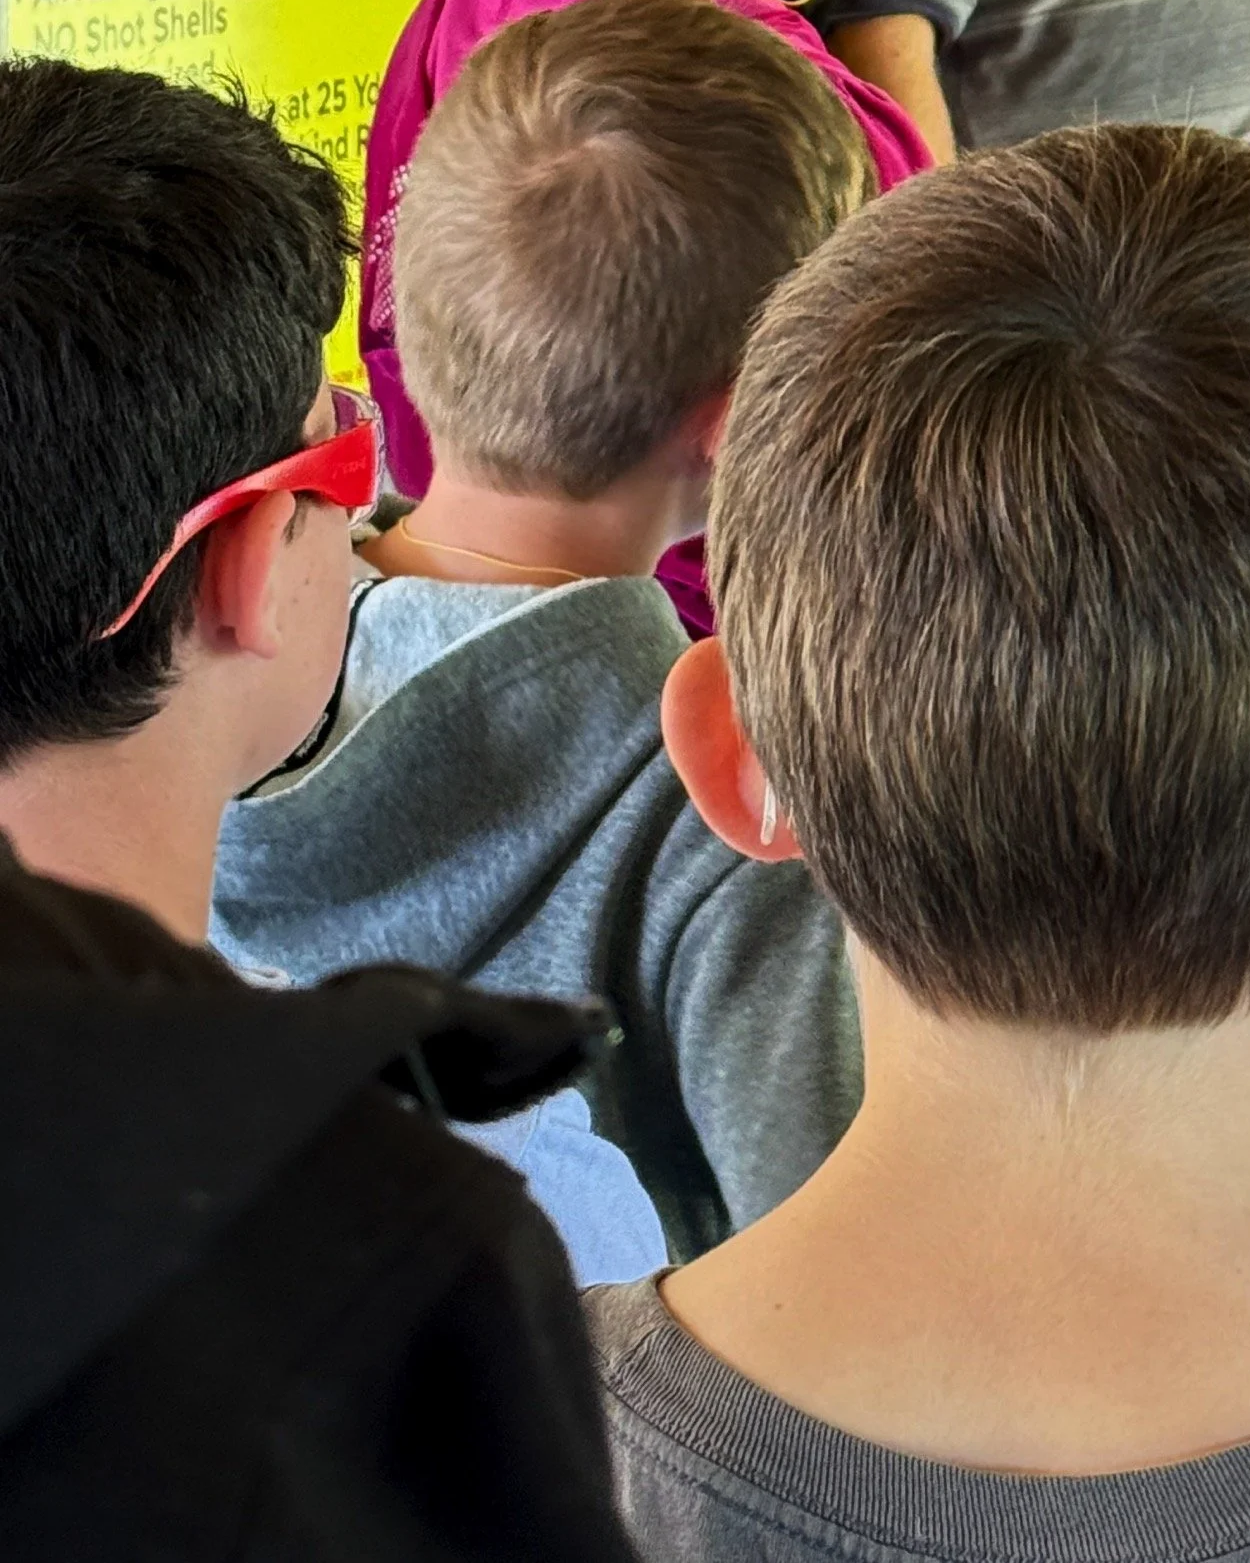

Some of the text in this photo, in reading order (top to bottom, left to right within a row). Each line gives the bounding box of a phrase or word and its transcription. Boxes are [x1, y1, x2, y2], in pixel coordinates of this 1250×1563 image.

[86, 13, 145, 55] Shot
[287, 90, 311, 122] at
[317, 78, 347, 116] 25
